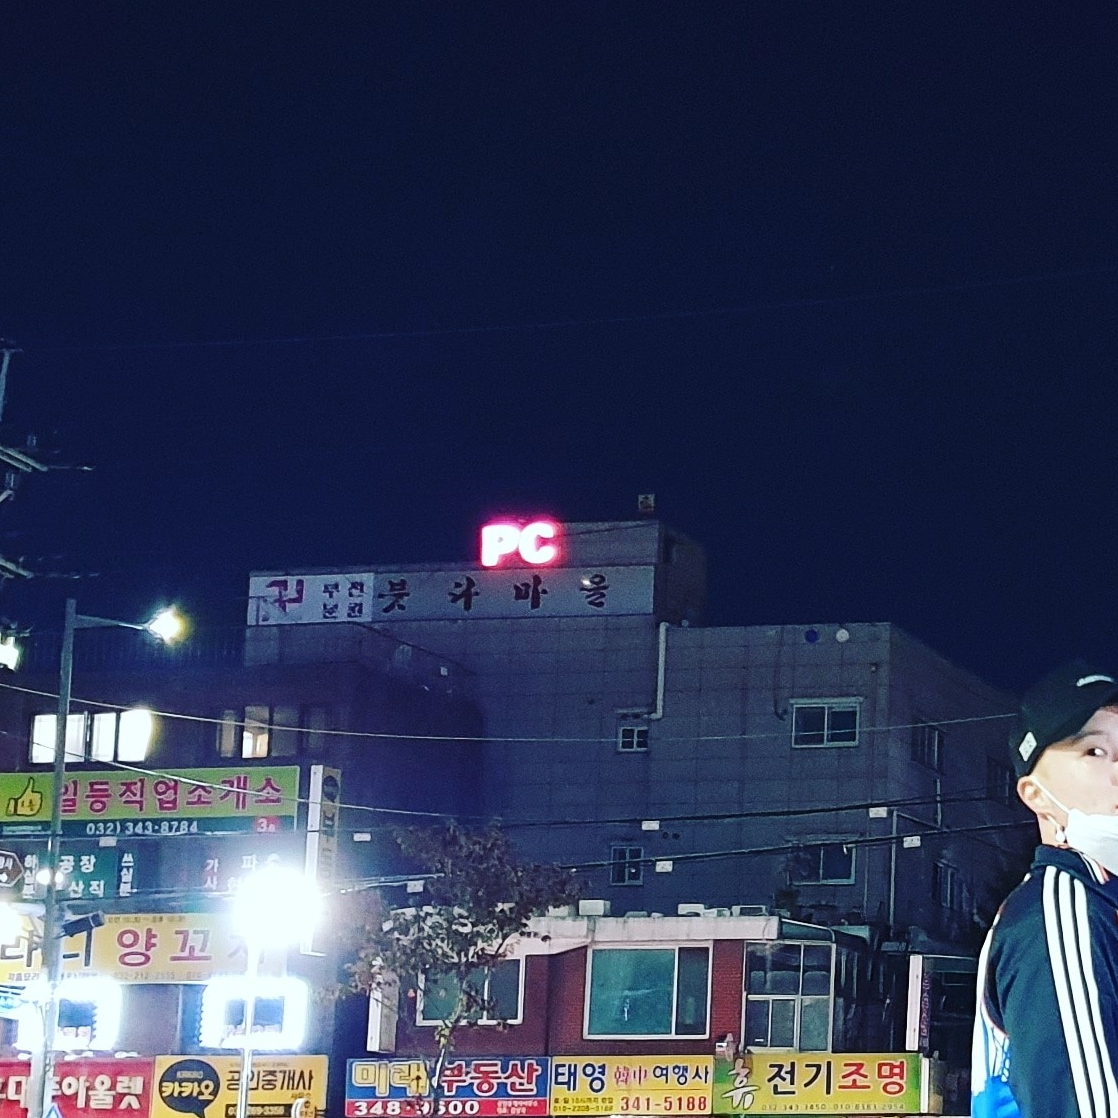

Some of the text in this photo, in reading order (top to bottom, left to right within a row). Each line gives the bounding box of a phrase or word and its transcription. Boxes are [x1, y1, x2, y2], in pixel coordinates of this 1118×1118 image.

[481, 522, 557, 567] PC
[61, 777, 283, 814] 일등직업소개소
[59, 855, 97, 873] 공장
[56, 880, 105, 898] 산직
[116, 927, 264, 967] 양꼬
[161, 1079, 216, 1100] 카카오
[351, 1060, 544, 1097] 미래 부동산
[554, 1063, 607, 1093] 태영
[652, 1064, 710, 1086] 여행사
[767, 1060, 907, 1096] 전기조명
[620, 1096, 708, 1112] 341-5188
